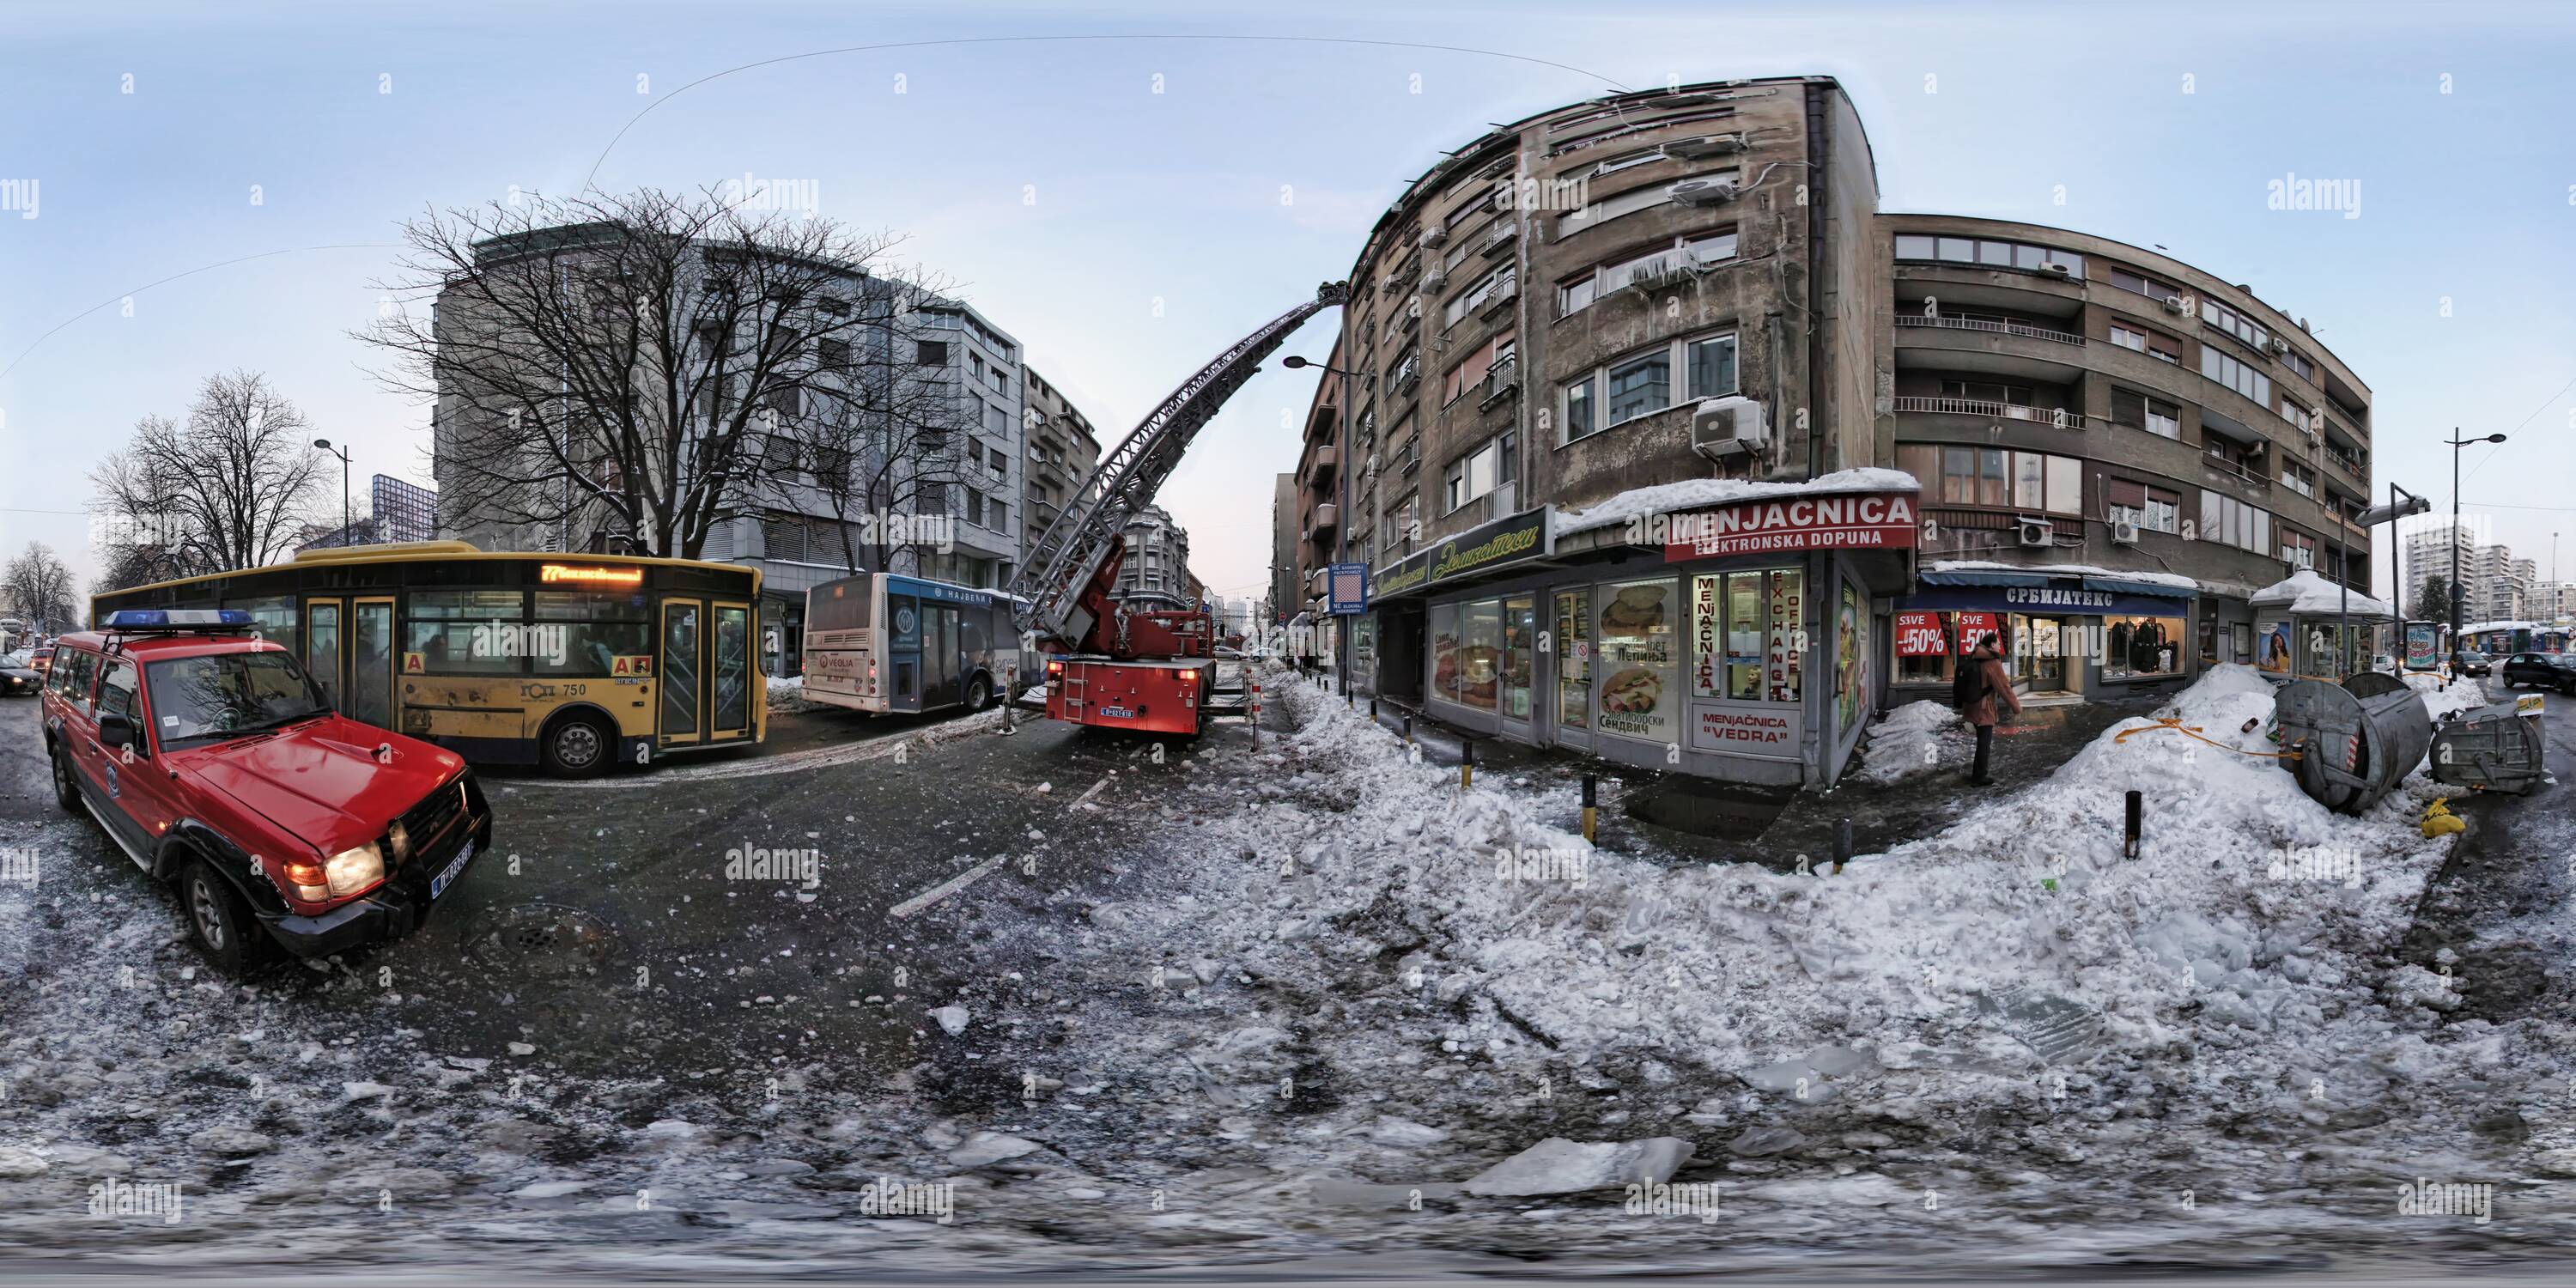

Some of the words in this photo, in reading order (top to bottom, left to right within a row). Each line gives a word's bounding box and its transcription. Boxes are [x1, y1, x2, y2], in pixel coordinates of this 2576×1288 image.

[1695, 534, 1805, 556] ELEKTRONSKA
[1811, 531, 1882, 546] DOPUNA
[948, 589, 986, 604] НАЈВЕЋИ
[2006, 587, 2113, 607] СРБИЈАТЕКС
[1961, 615, 1984, 625] SVE
[1618, 647, 1668, 662] Лепиња
[408, 655, 422, 670] A
[614, 659, 629, 674] A
[829, 659, 854, 667] VEOLIA
[563, 683, 586, 696] 750
[1607, 707, 1664, 726] Златиборски
[1600, 714, 1649, 735] Сендвич
